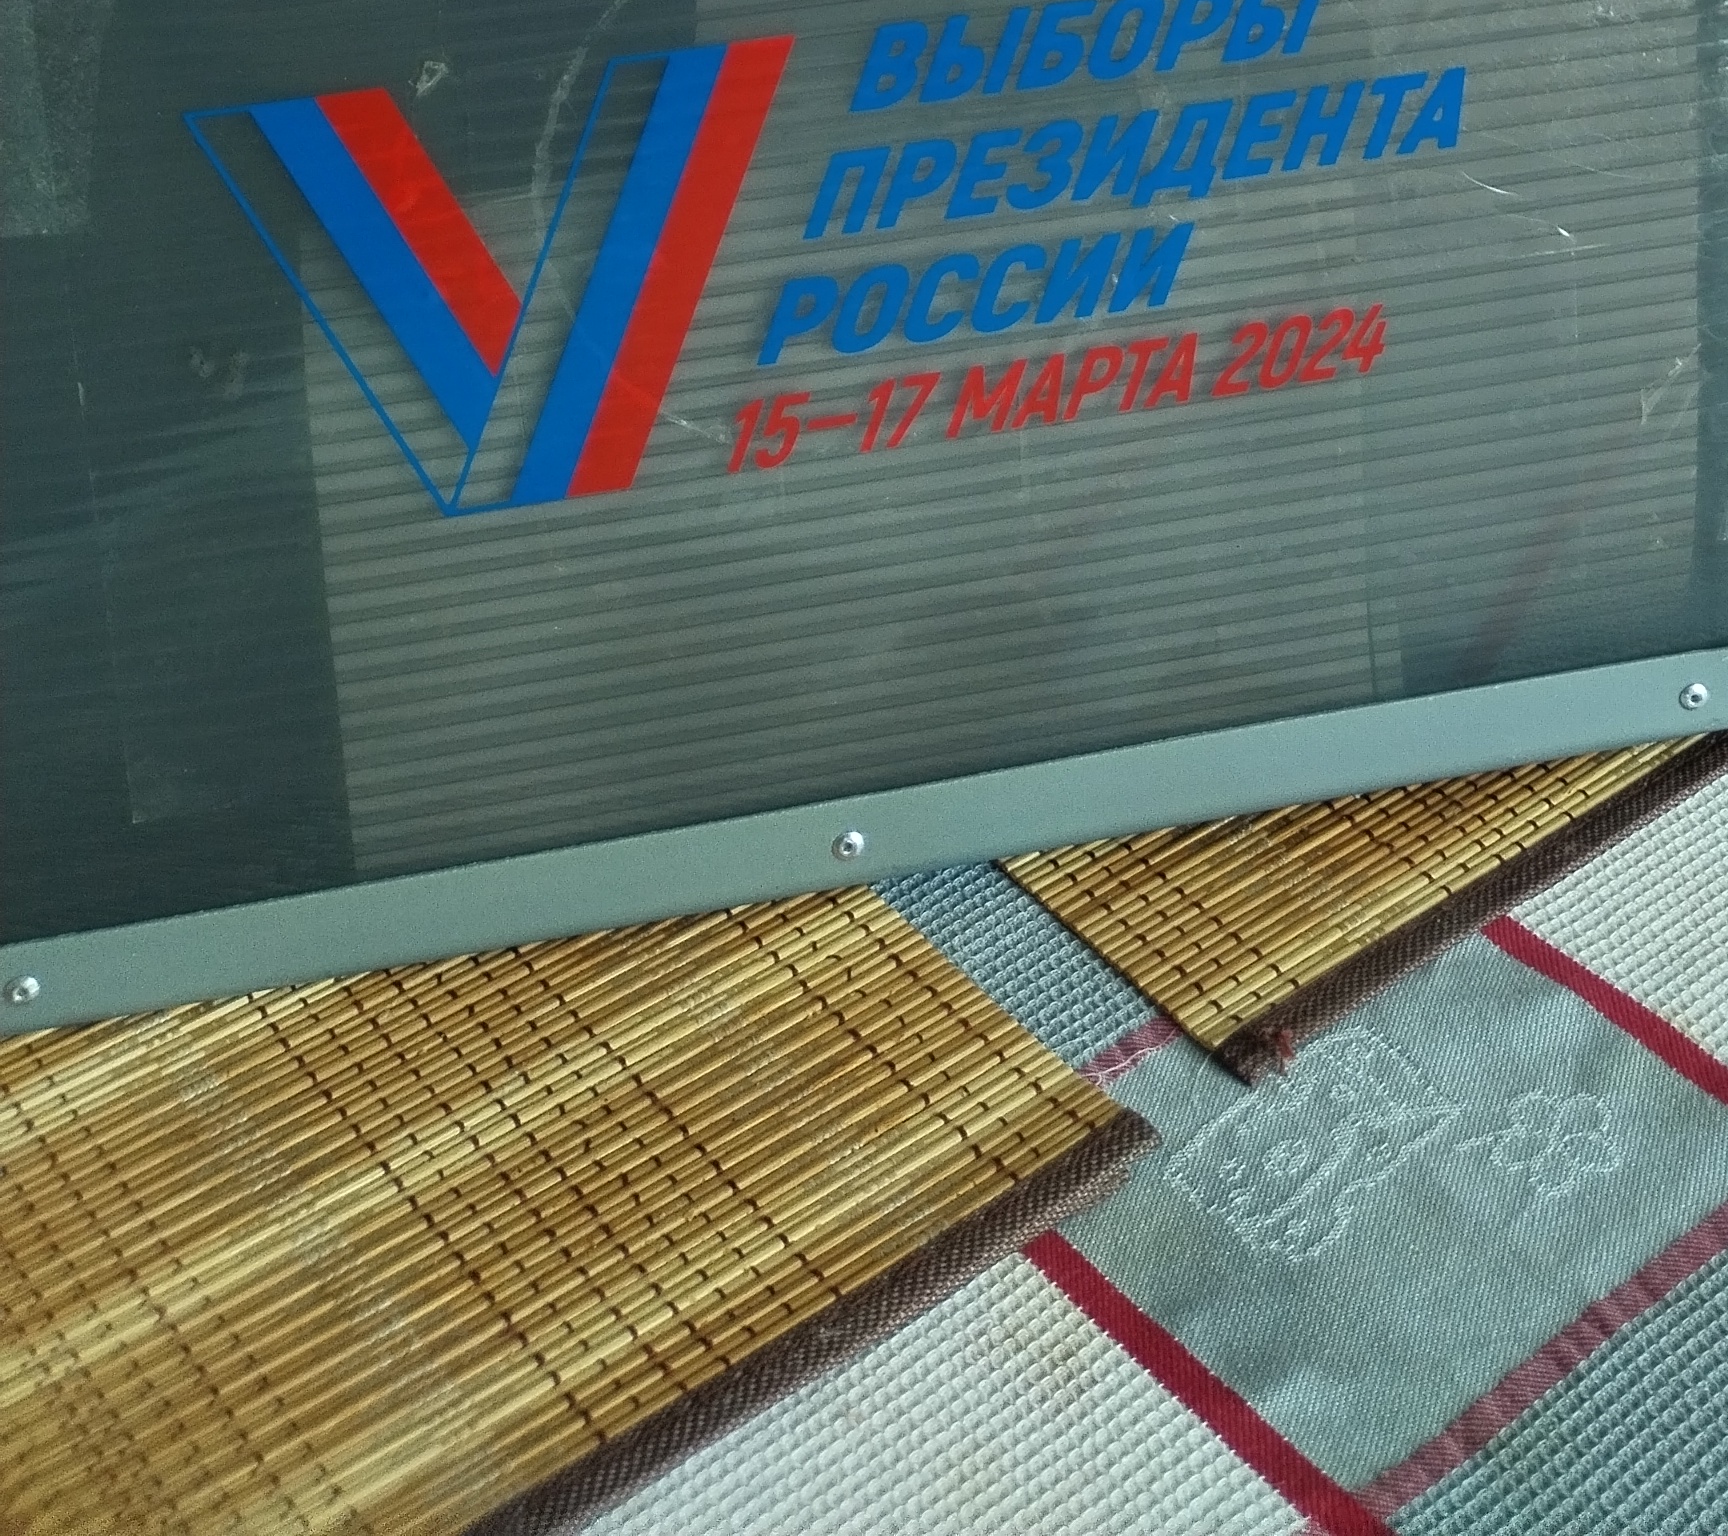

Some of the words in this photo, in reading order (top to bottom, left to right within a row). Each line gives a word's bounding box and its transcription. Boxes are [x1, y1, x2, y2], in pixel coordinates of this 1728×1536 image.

[803, 66, 1467, 240] ПРЕЗИДЕНТА
[757, 221, 1196, 366] РОССИИ
[946, 332, 1198, 439] МАРТА
[1212, 304, 1386, 398] 2024
